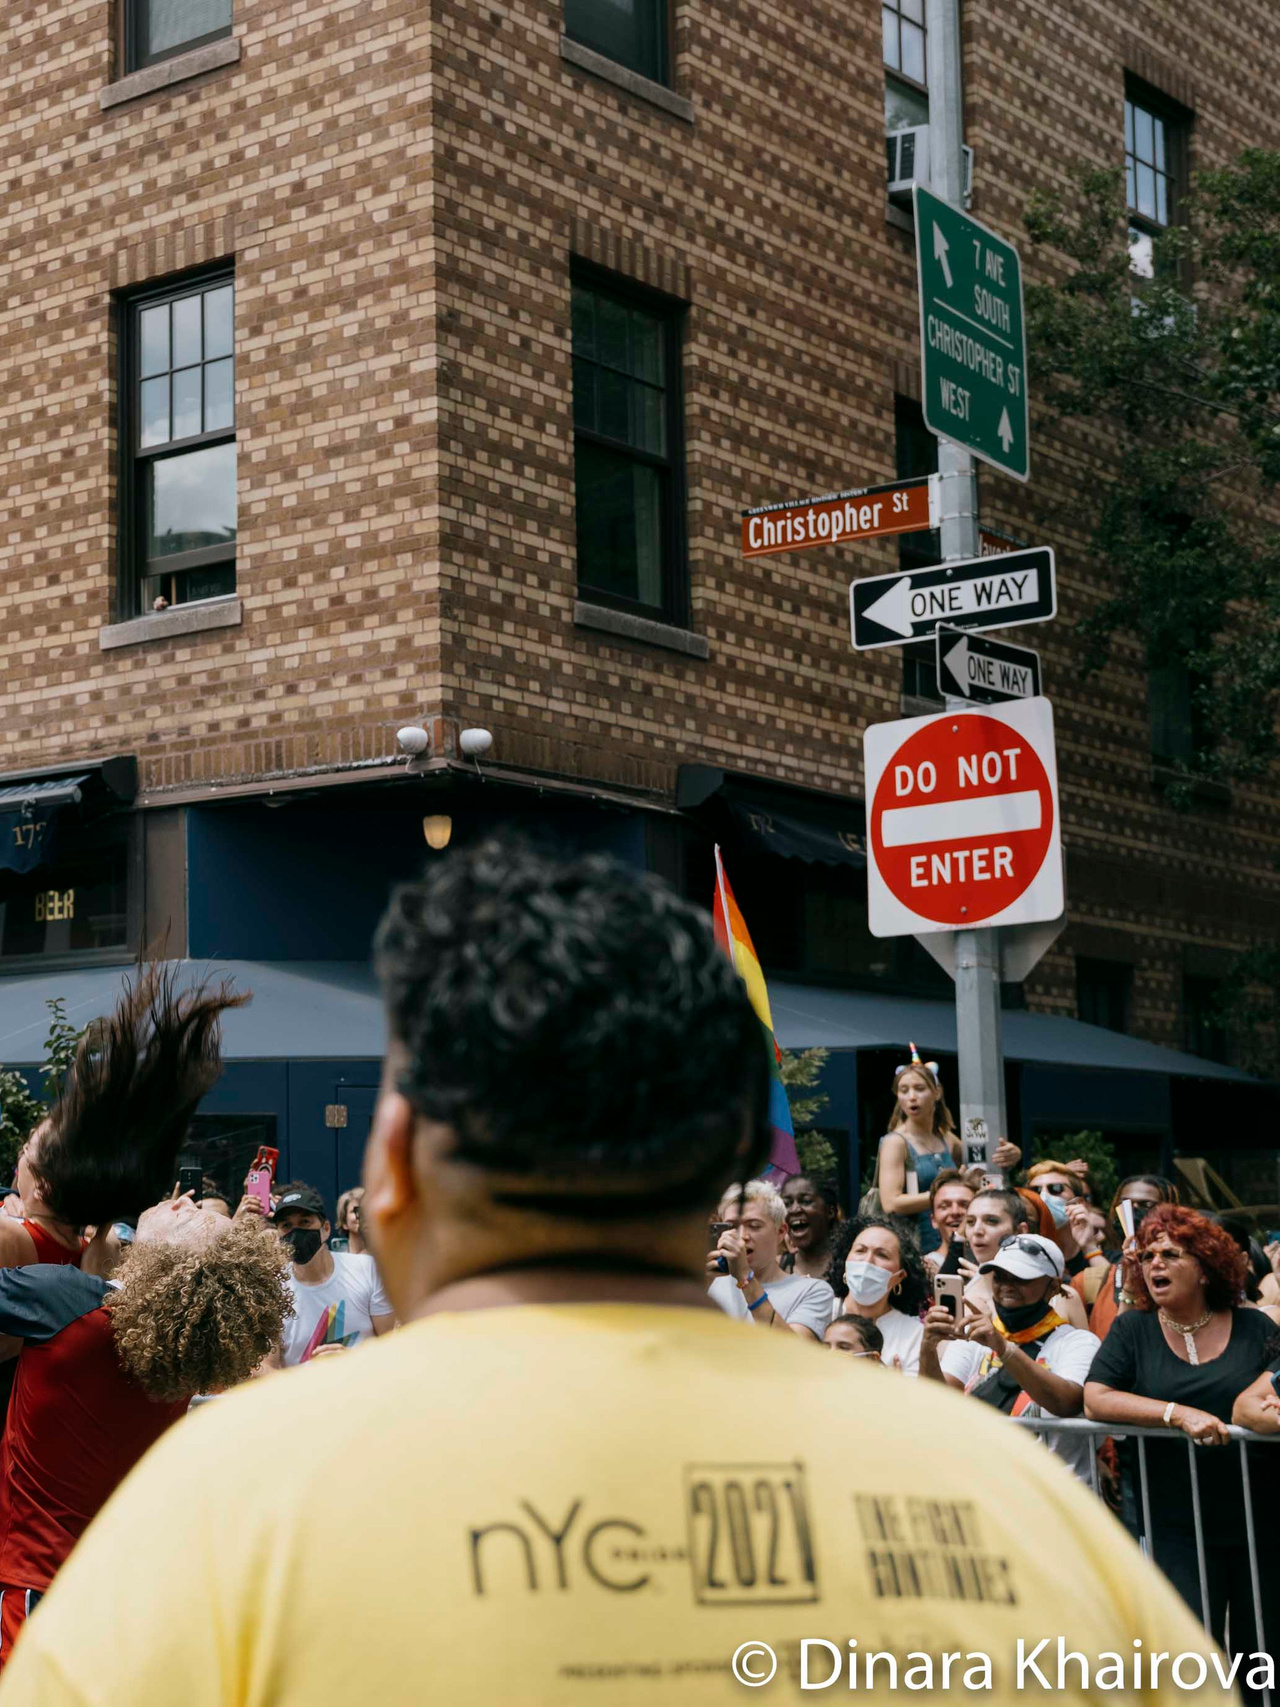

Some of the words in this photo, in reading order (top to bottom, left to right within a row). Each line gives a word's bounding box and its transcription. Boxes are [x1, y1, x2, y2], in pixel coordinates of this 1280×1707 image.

[973, 240, 981, 269] 7
[985, 249, 1006, 288] AVE
[974, 285, 1010, 333] SOUTH
[927, 315, 1003, 388] CHRISTOPHER
[1007, 363, 1020, 397] ST
[940, 376, 971, 422] WEST
[748, 502, 883, 549] Christopher
[892, 492, 909, 513] St
[911, 586, 963, 618] ONE
[973, 574, 1029, 606] WAY
[967, 655, 995, 687] ONE
[999, 663, 1028, 694] WAY
[894, 761, 937, 797] DO
[958, 748, 1021, 788] NOT
[910, 846, 1014, 888] ENTER
[35, 889, 75, 921] BEER
